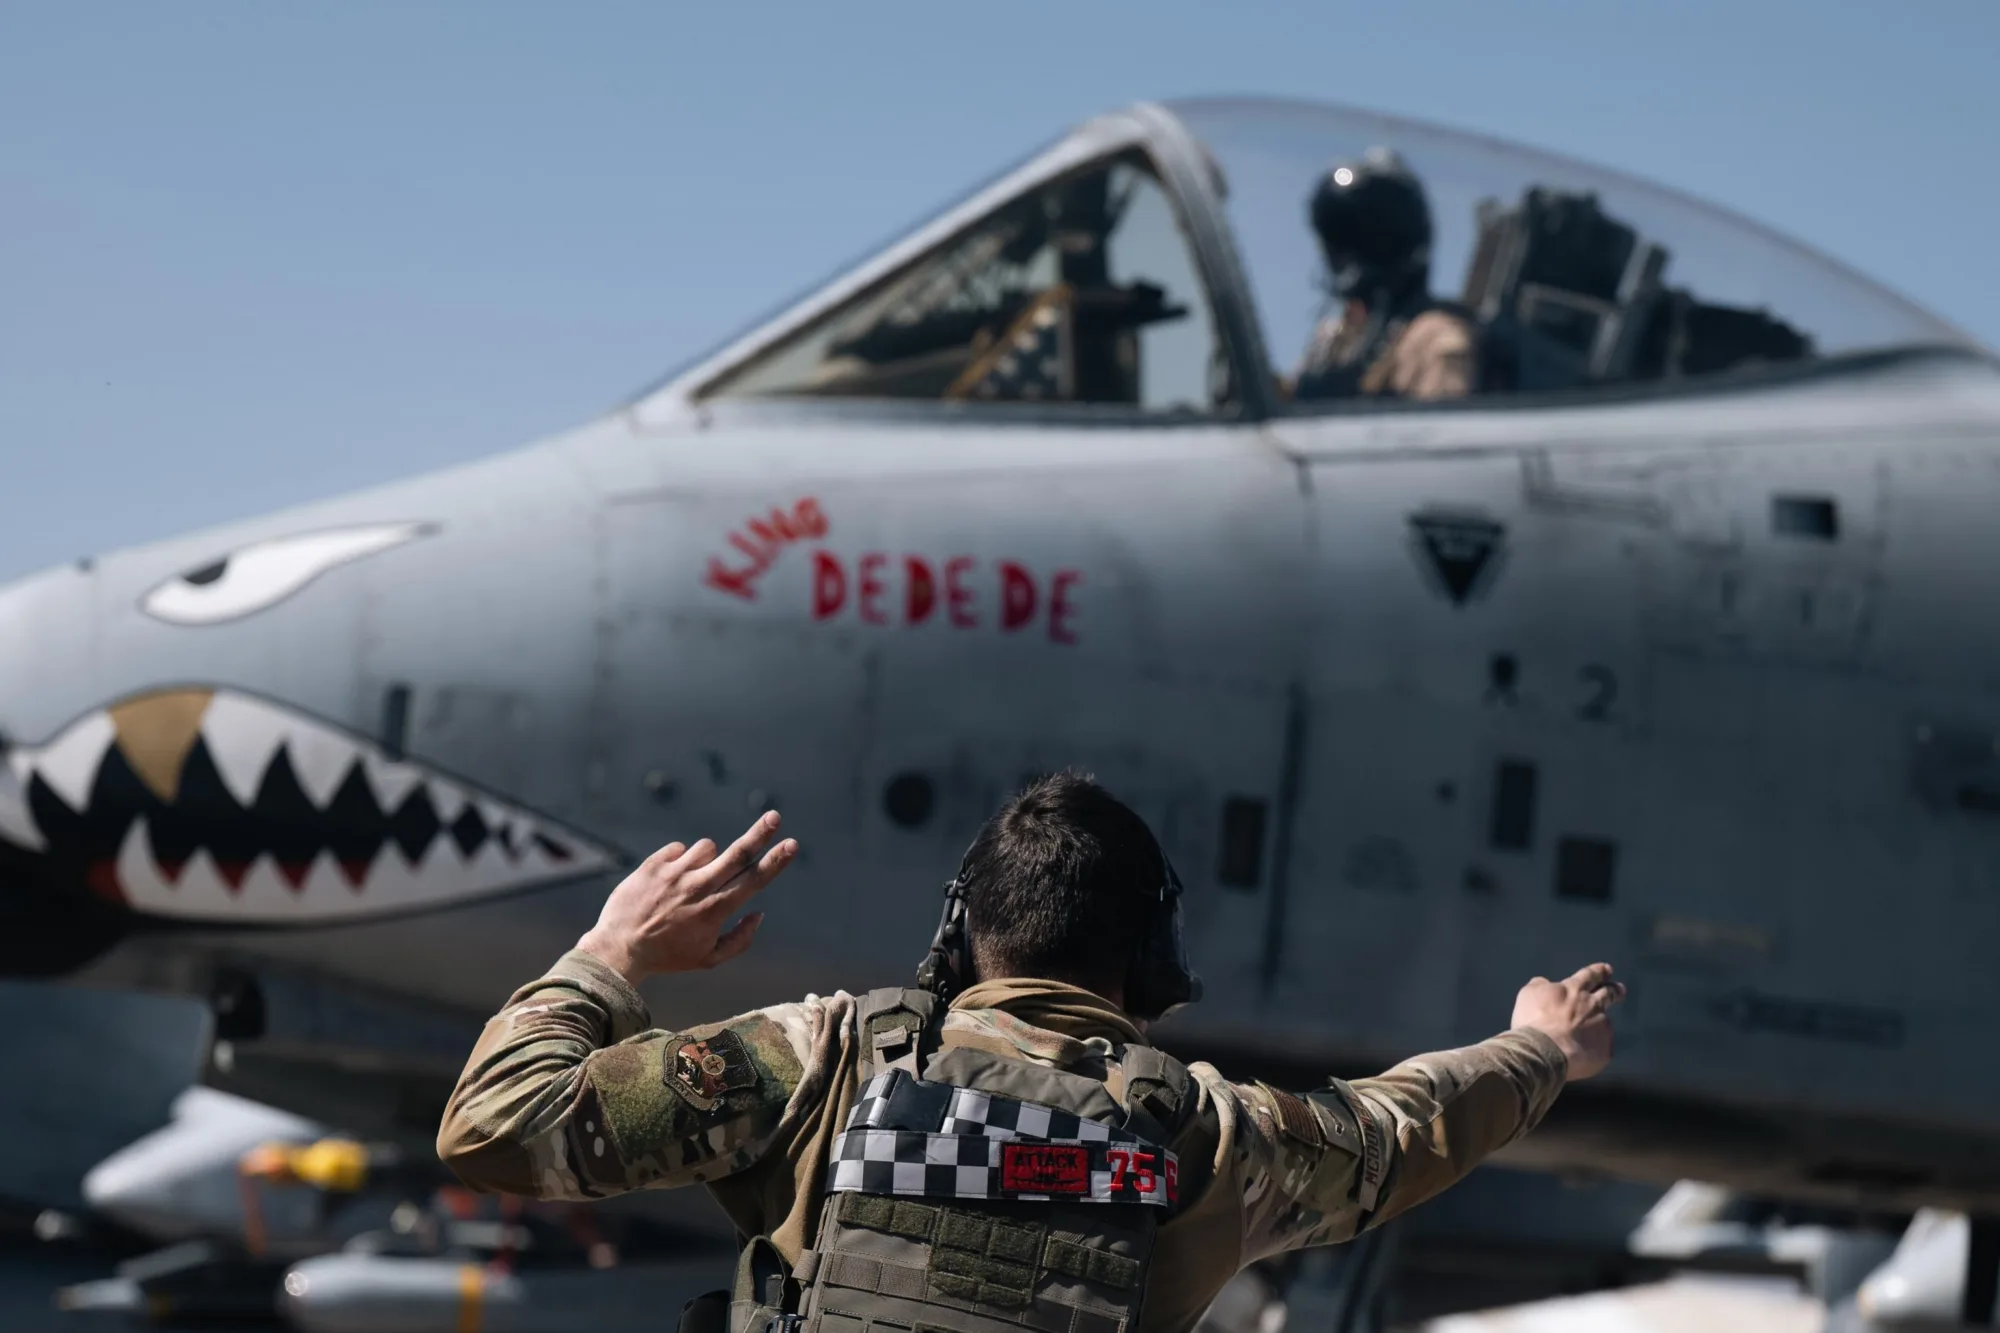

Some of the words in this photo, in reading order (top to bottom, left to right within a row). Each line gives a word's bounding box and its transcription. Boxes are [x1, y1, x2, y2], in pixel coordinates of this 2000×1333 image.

[702, 497, 829, 601] KING
[812, 550, 1084, 645] DEDEDE
[1014, 1152, 1077, 1169] ATTACK
[1106, 1150, 1156, 1192] 75
